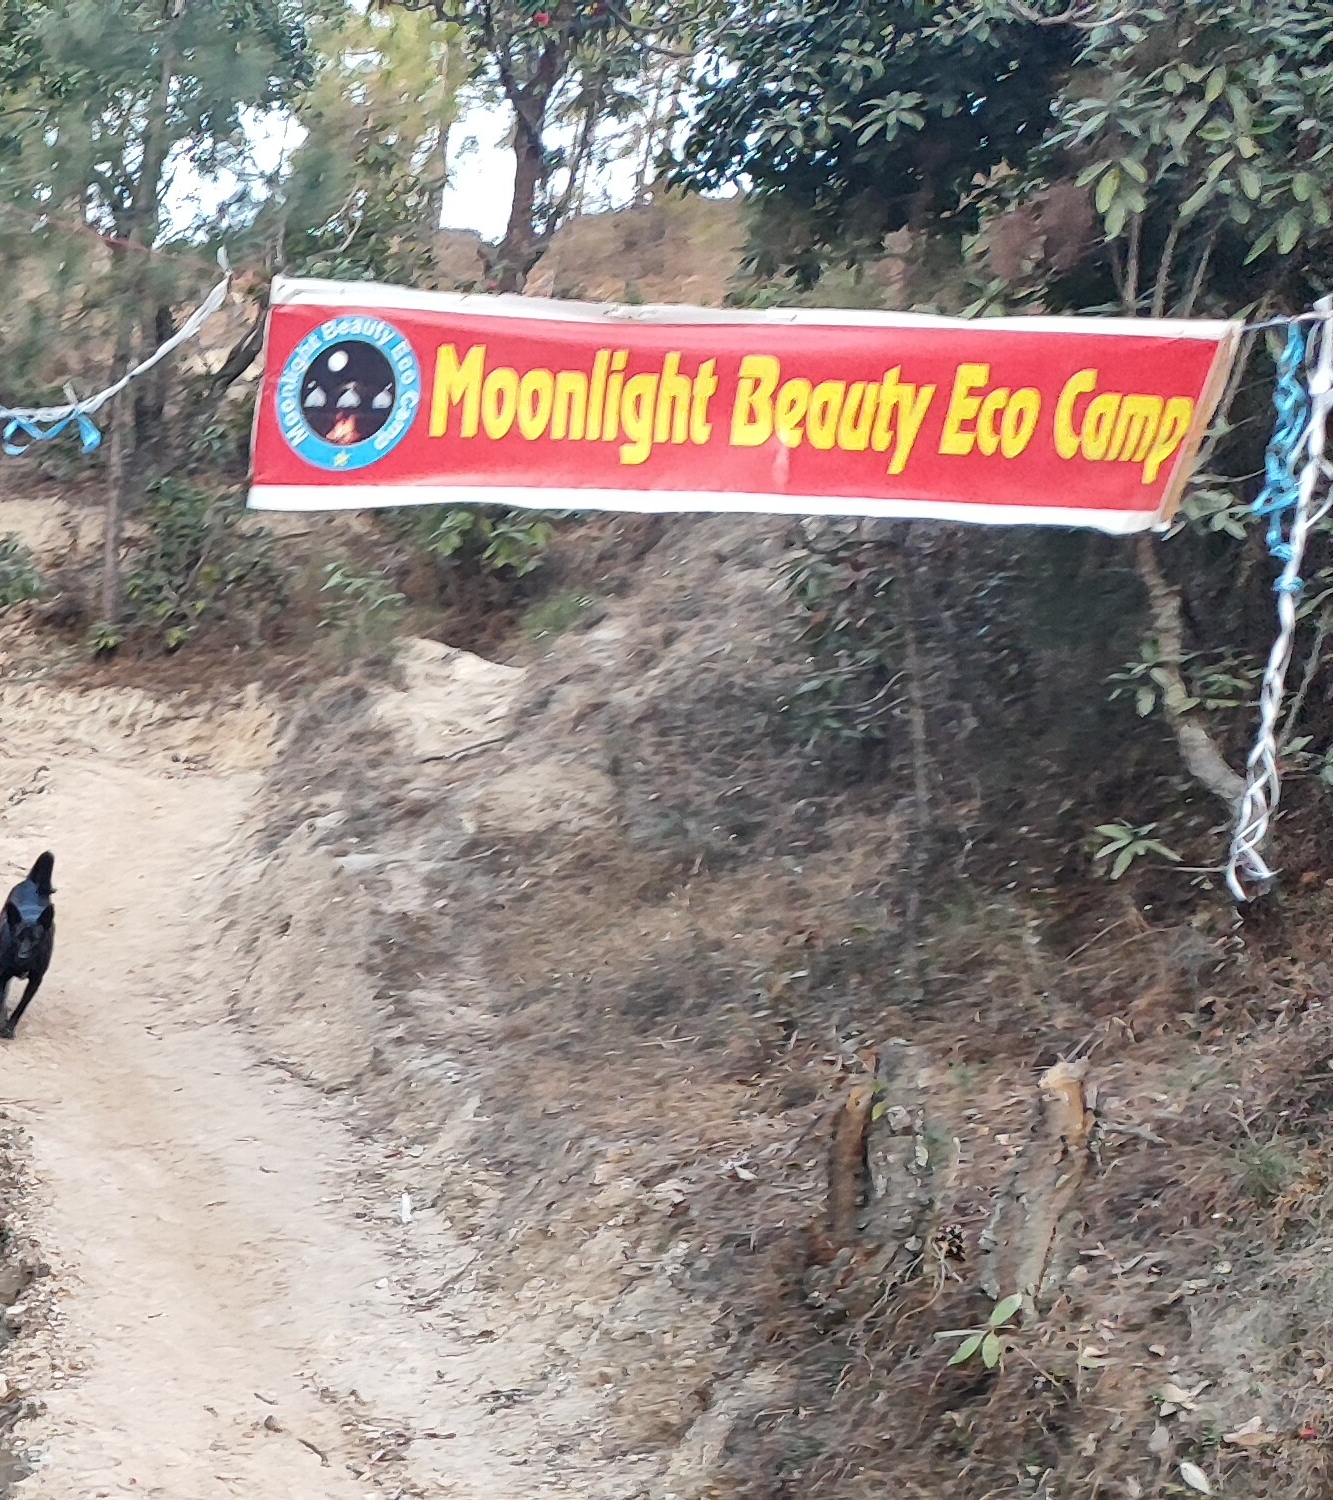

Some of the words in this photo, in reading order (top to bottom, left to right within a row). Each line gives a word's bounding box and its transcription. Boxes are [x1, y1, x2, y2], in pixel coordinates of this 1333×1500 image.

[321, 318, 396, 346] Beauty
[429, 343, 718, 465] Moonlight
[729, 354, 936, 475] Beauty
[938, 362, 1041, 459] Eco
[1053, 367, 1194, 485] Camp
